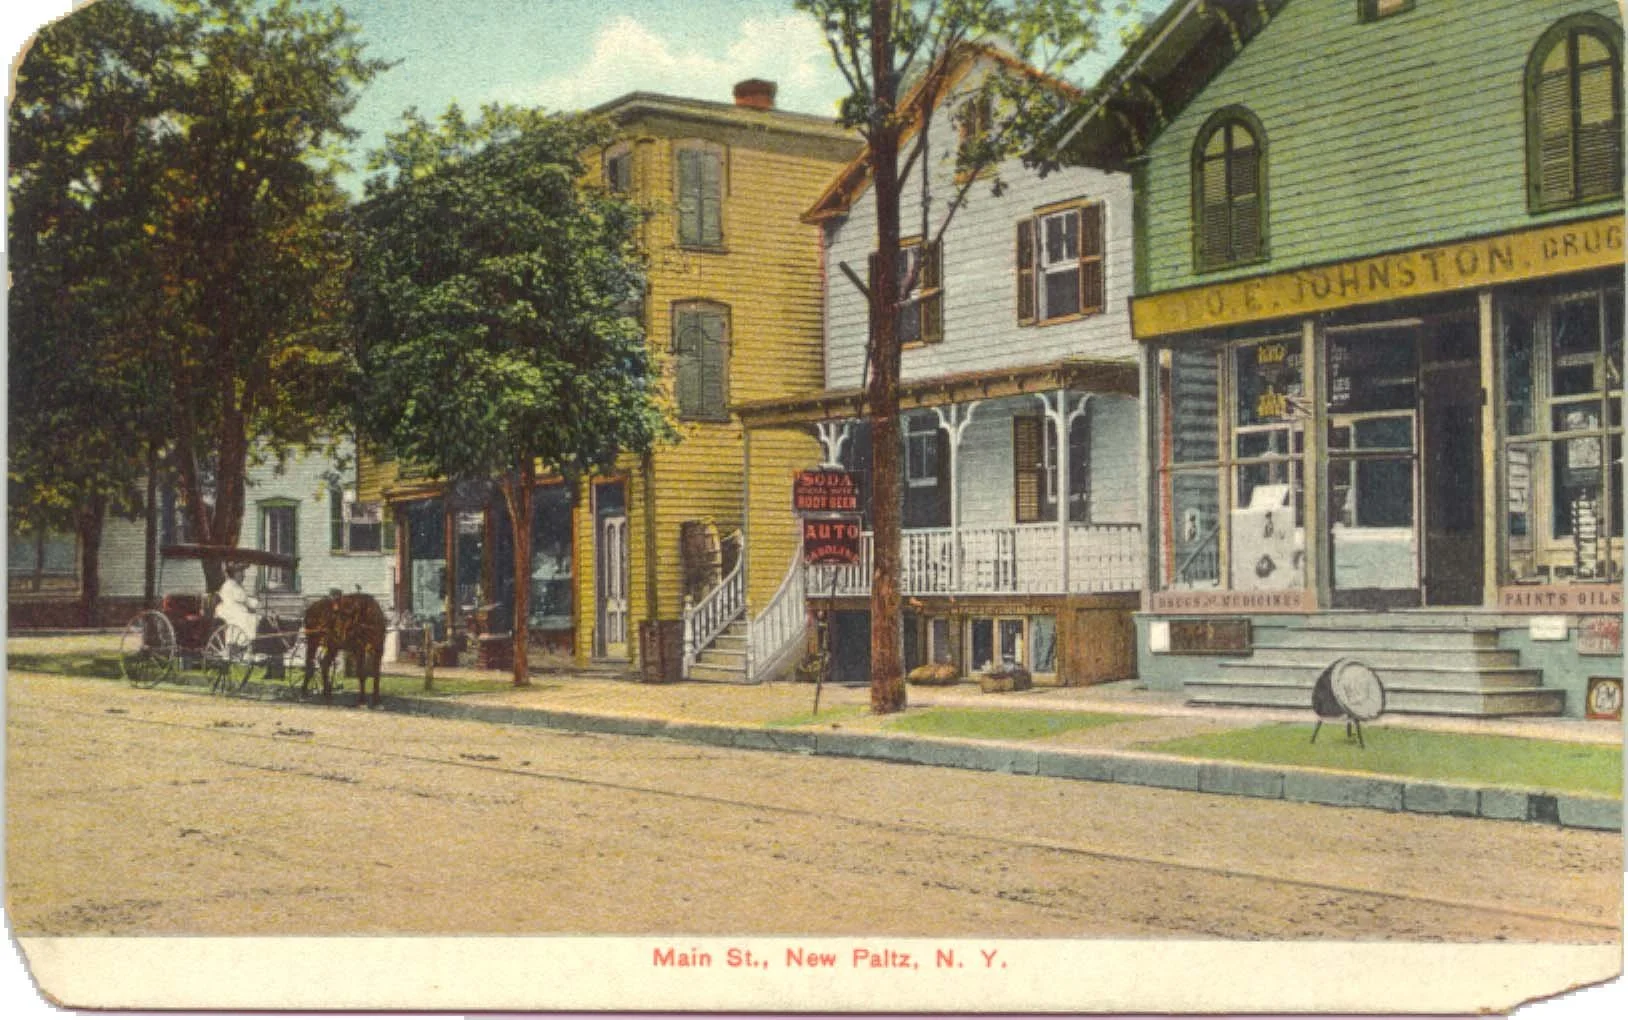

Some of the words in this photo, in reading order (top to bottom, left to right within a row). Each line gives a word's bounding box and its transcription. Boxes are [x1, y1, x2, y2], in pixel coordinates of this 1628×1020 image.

[800, 472, 853, 486] SODA
[797, 495, 826, 509] ROOT
[829, 495, 857, 509] BEER
[805, 524, 859, 539] AUTO
[1222, 594, 1301, 609] MEDICINES
[1504, 592, 1569, 606] PAINTS
[1578, 591, 1621, 605] OILS
